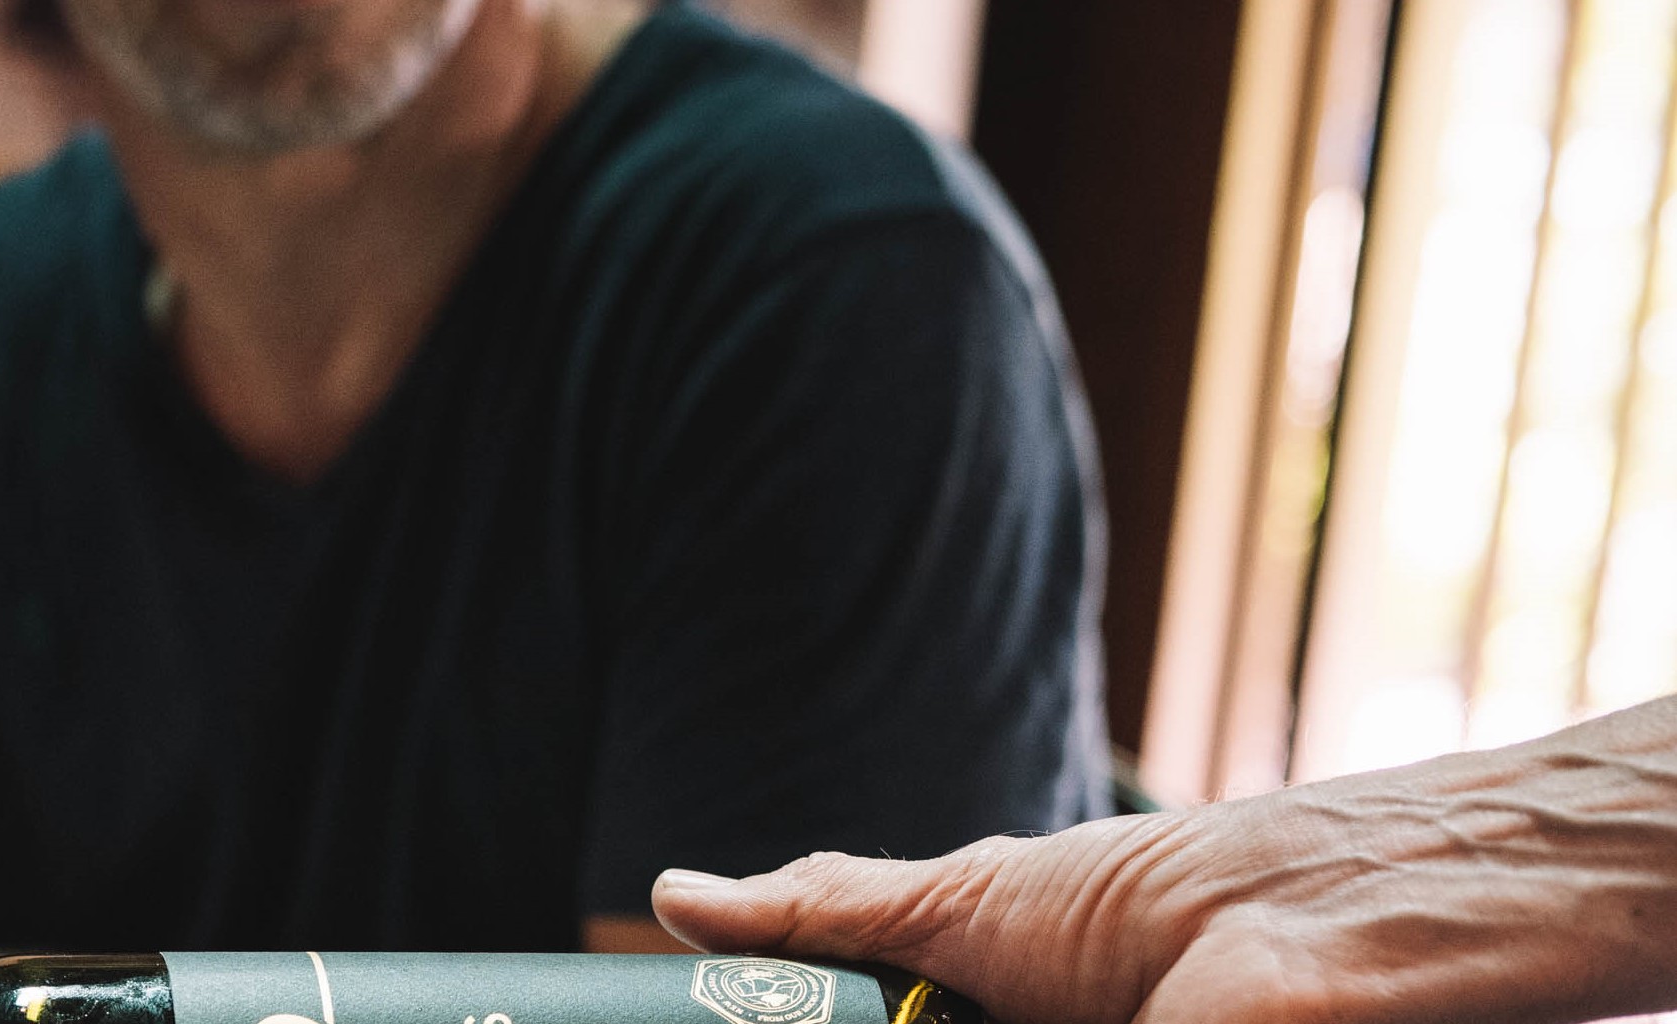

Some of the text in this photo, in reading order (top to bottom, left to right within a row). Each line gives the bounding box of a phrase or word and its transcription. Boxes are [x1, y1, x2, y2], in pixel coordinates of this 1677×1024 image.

[723, 1001, 744, 1015] NEW
[757, 1013, 785, 1023] FROM
[785, 1009, 804, 1021] OUR
